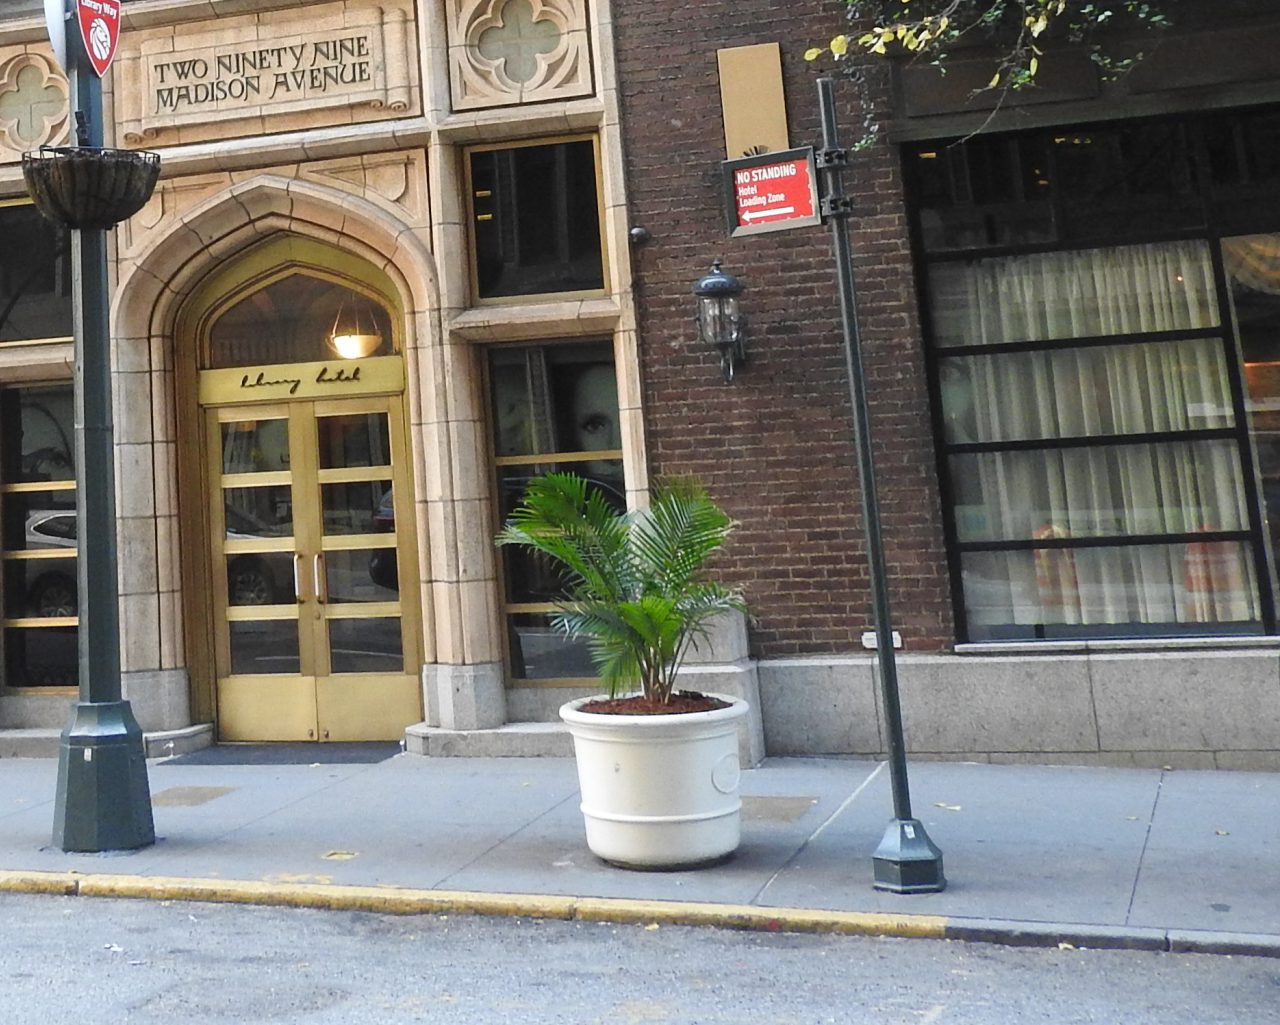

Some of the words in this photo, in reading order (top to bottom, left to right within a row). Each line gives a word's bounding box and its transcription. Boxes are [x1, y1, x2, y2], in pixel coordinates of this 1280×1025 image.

[103, 2, 117, 19] Way
[155, 59, 208, 83] TWO
[216, 43, 307, 80] NINETY
[311, 36, 369, 67] NINE
[155, 76, 260, 114] MADISON
[270, 62, 370, 99] AVENUE
[737, 171, 750, 184] NO
[752, 164, 797, 181] STANDING
[738, 185, 758, 196] Hotel
[739, 193, 766, 207] Loading
[768, 192, 785, 203] Zone
